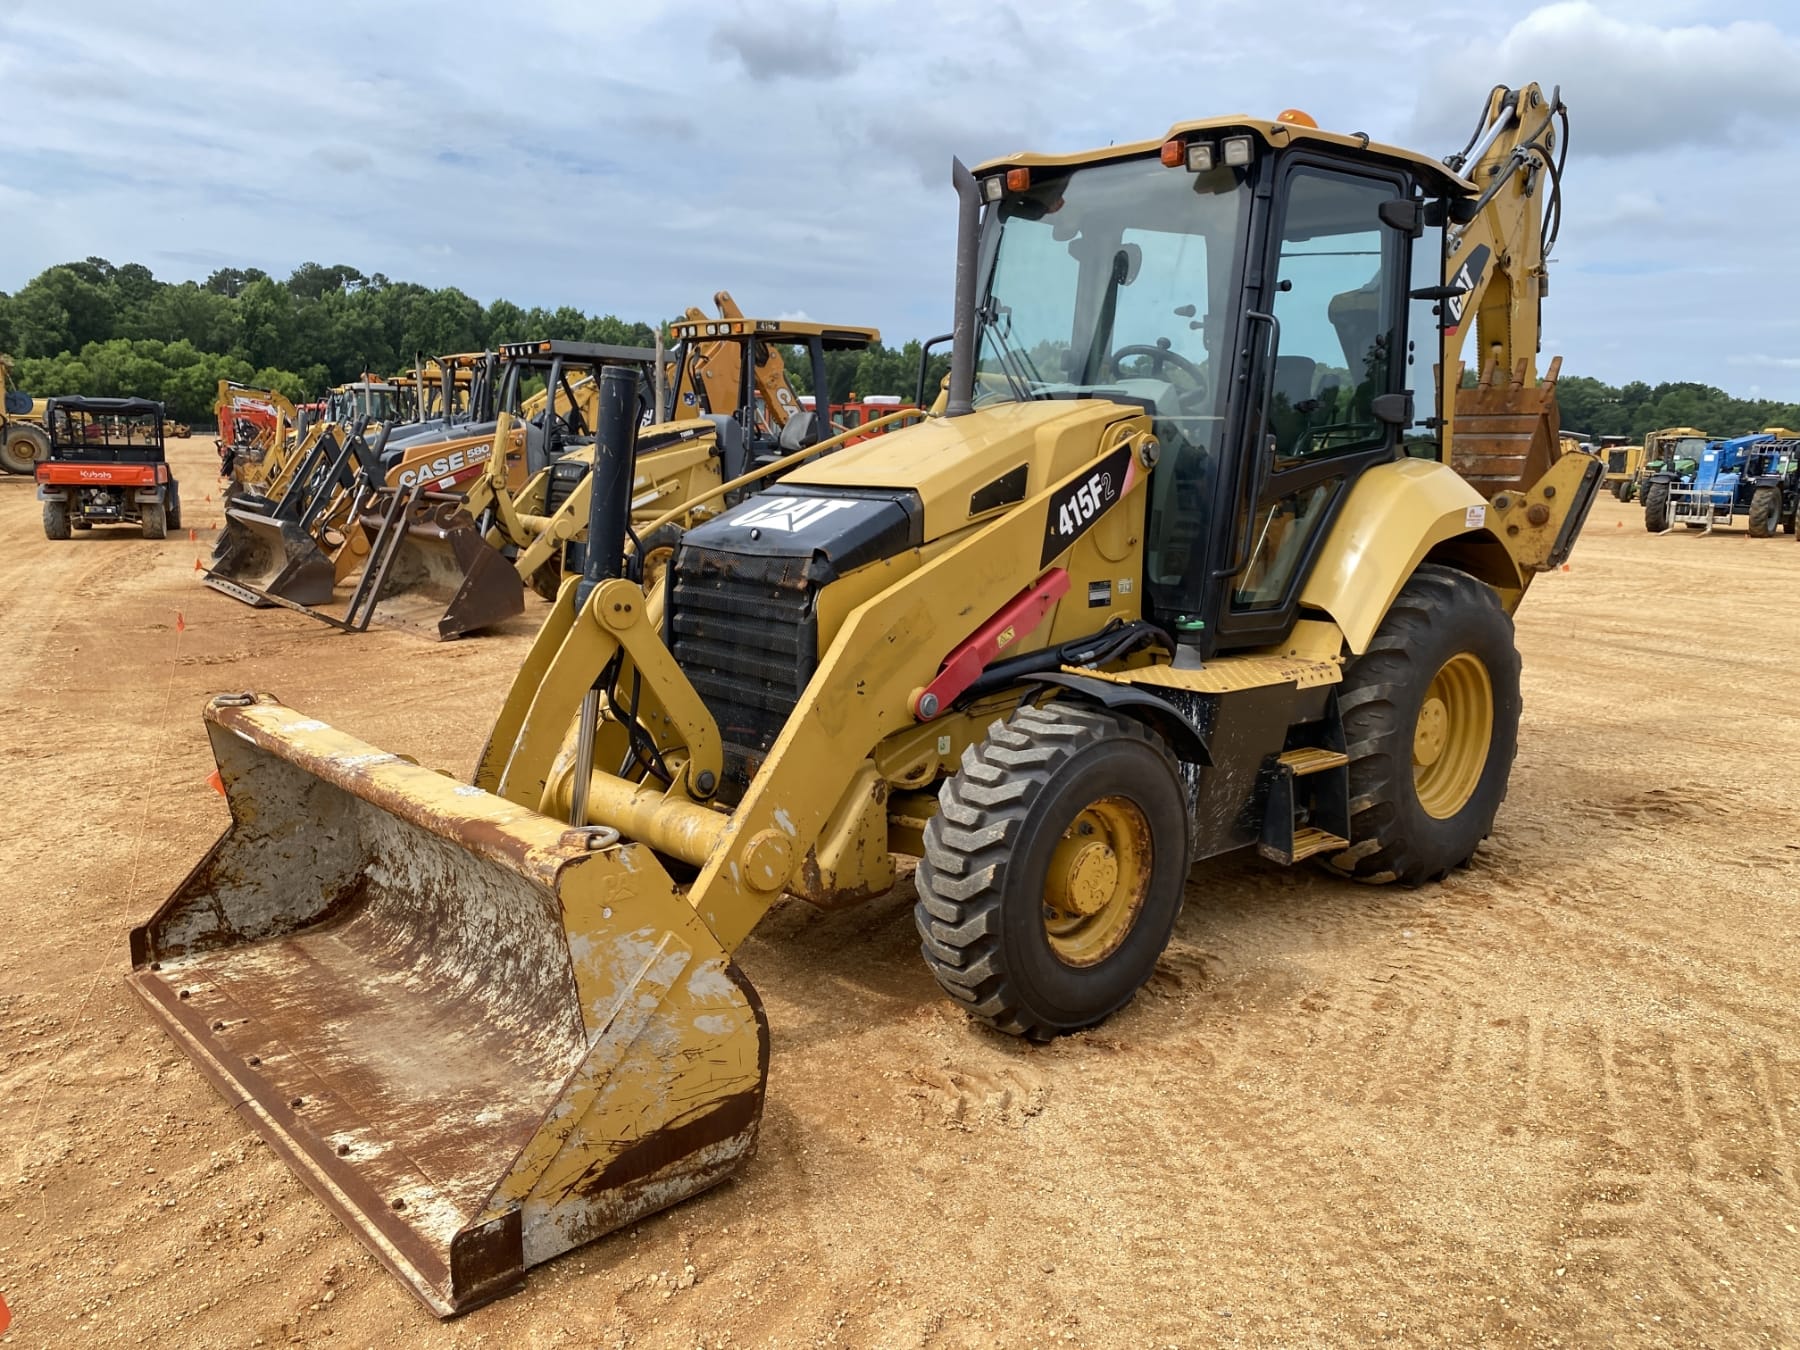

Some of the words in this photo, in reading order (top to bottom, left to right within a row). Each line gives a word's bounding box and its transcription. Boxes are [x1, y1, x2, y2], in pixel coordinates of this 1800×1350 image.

[1449, 262, 1474, 321] CAT
[80, 470, 112, 480] Kubota
[399, 451, 464, 488] CASE
[467, 444, 490, 458] 580
[729, 497, 859, 533] CAT
